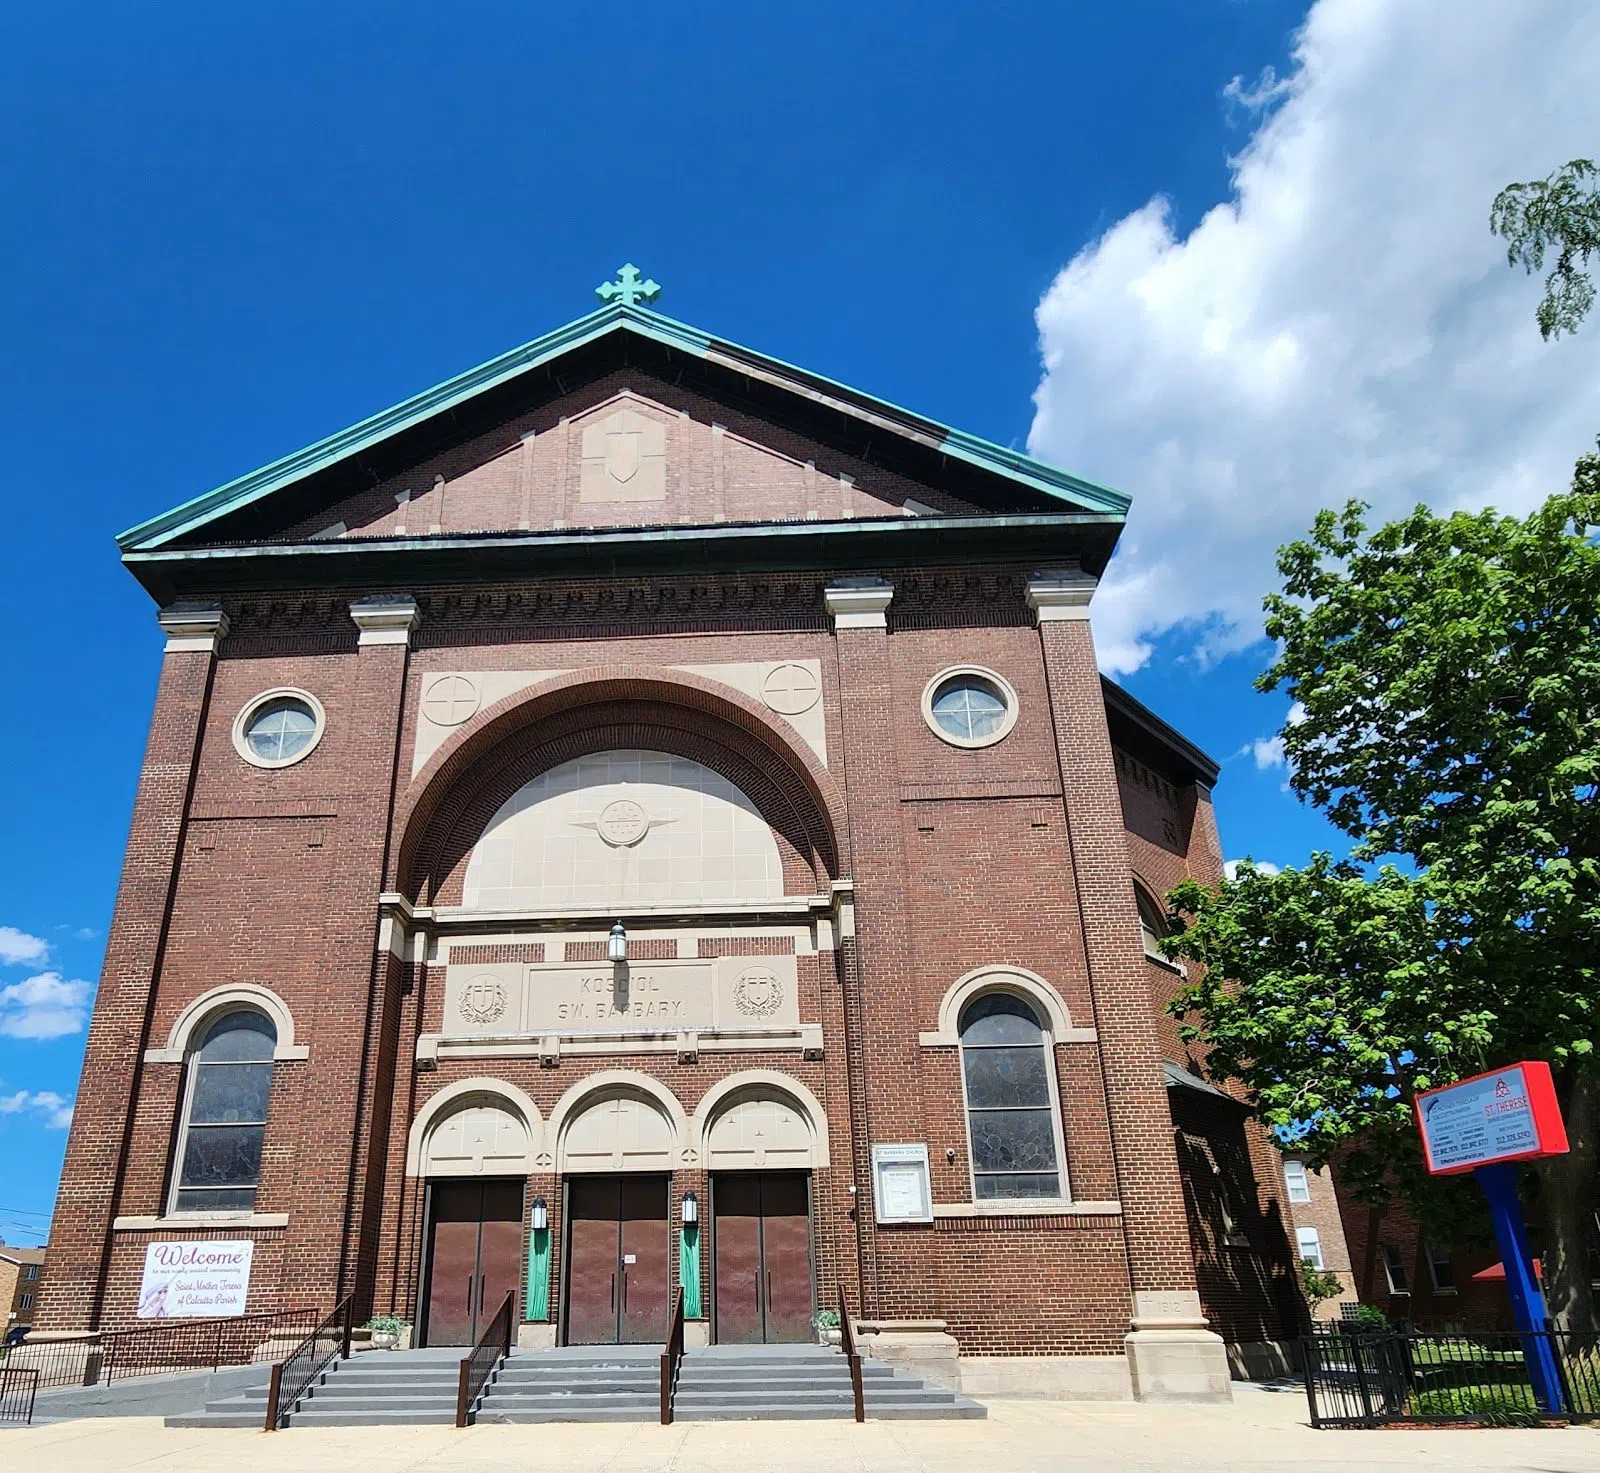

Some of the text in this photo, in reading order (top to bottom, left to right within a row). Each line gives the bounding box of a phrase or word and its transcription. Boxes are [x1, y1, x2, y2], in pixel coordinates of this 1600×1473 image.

[1485, 1104, 1496, 1117] ST.
[1496, 1096, 1528, 1112] THERESE
[154, 1245, 244, 1266] Welcome
[175, 1279, 242, 1291] Saint Mother Teresa
[177, 1295, 185, 1307] of
[214, 1293, 238, 1305] Parish
